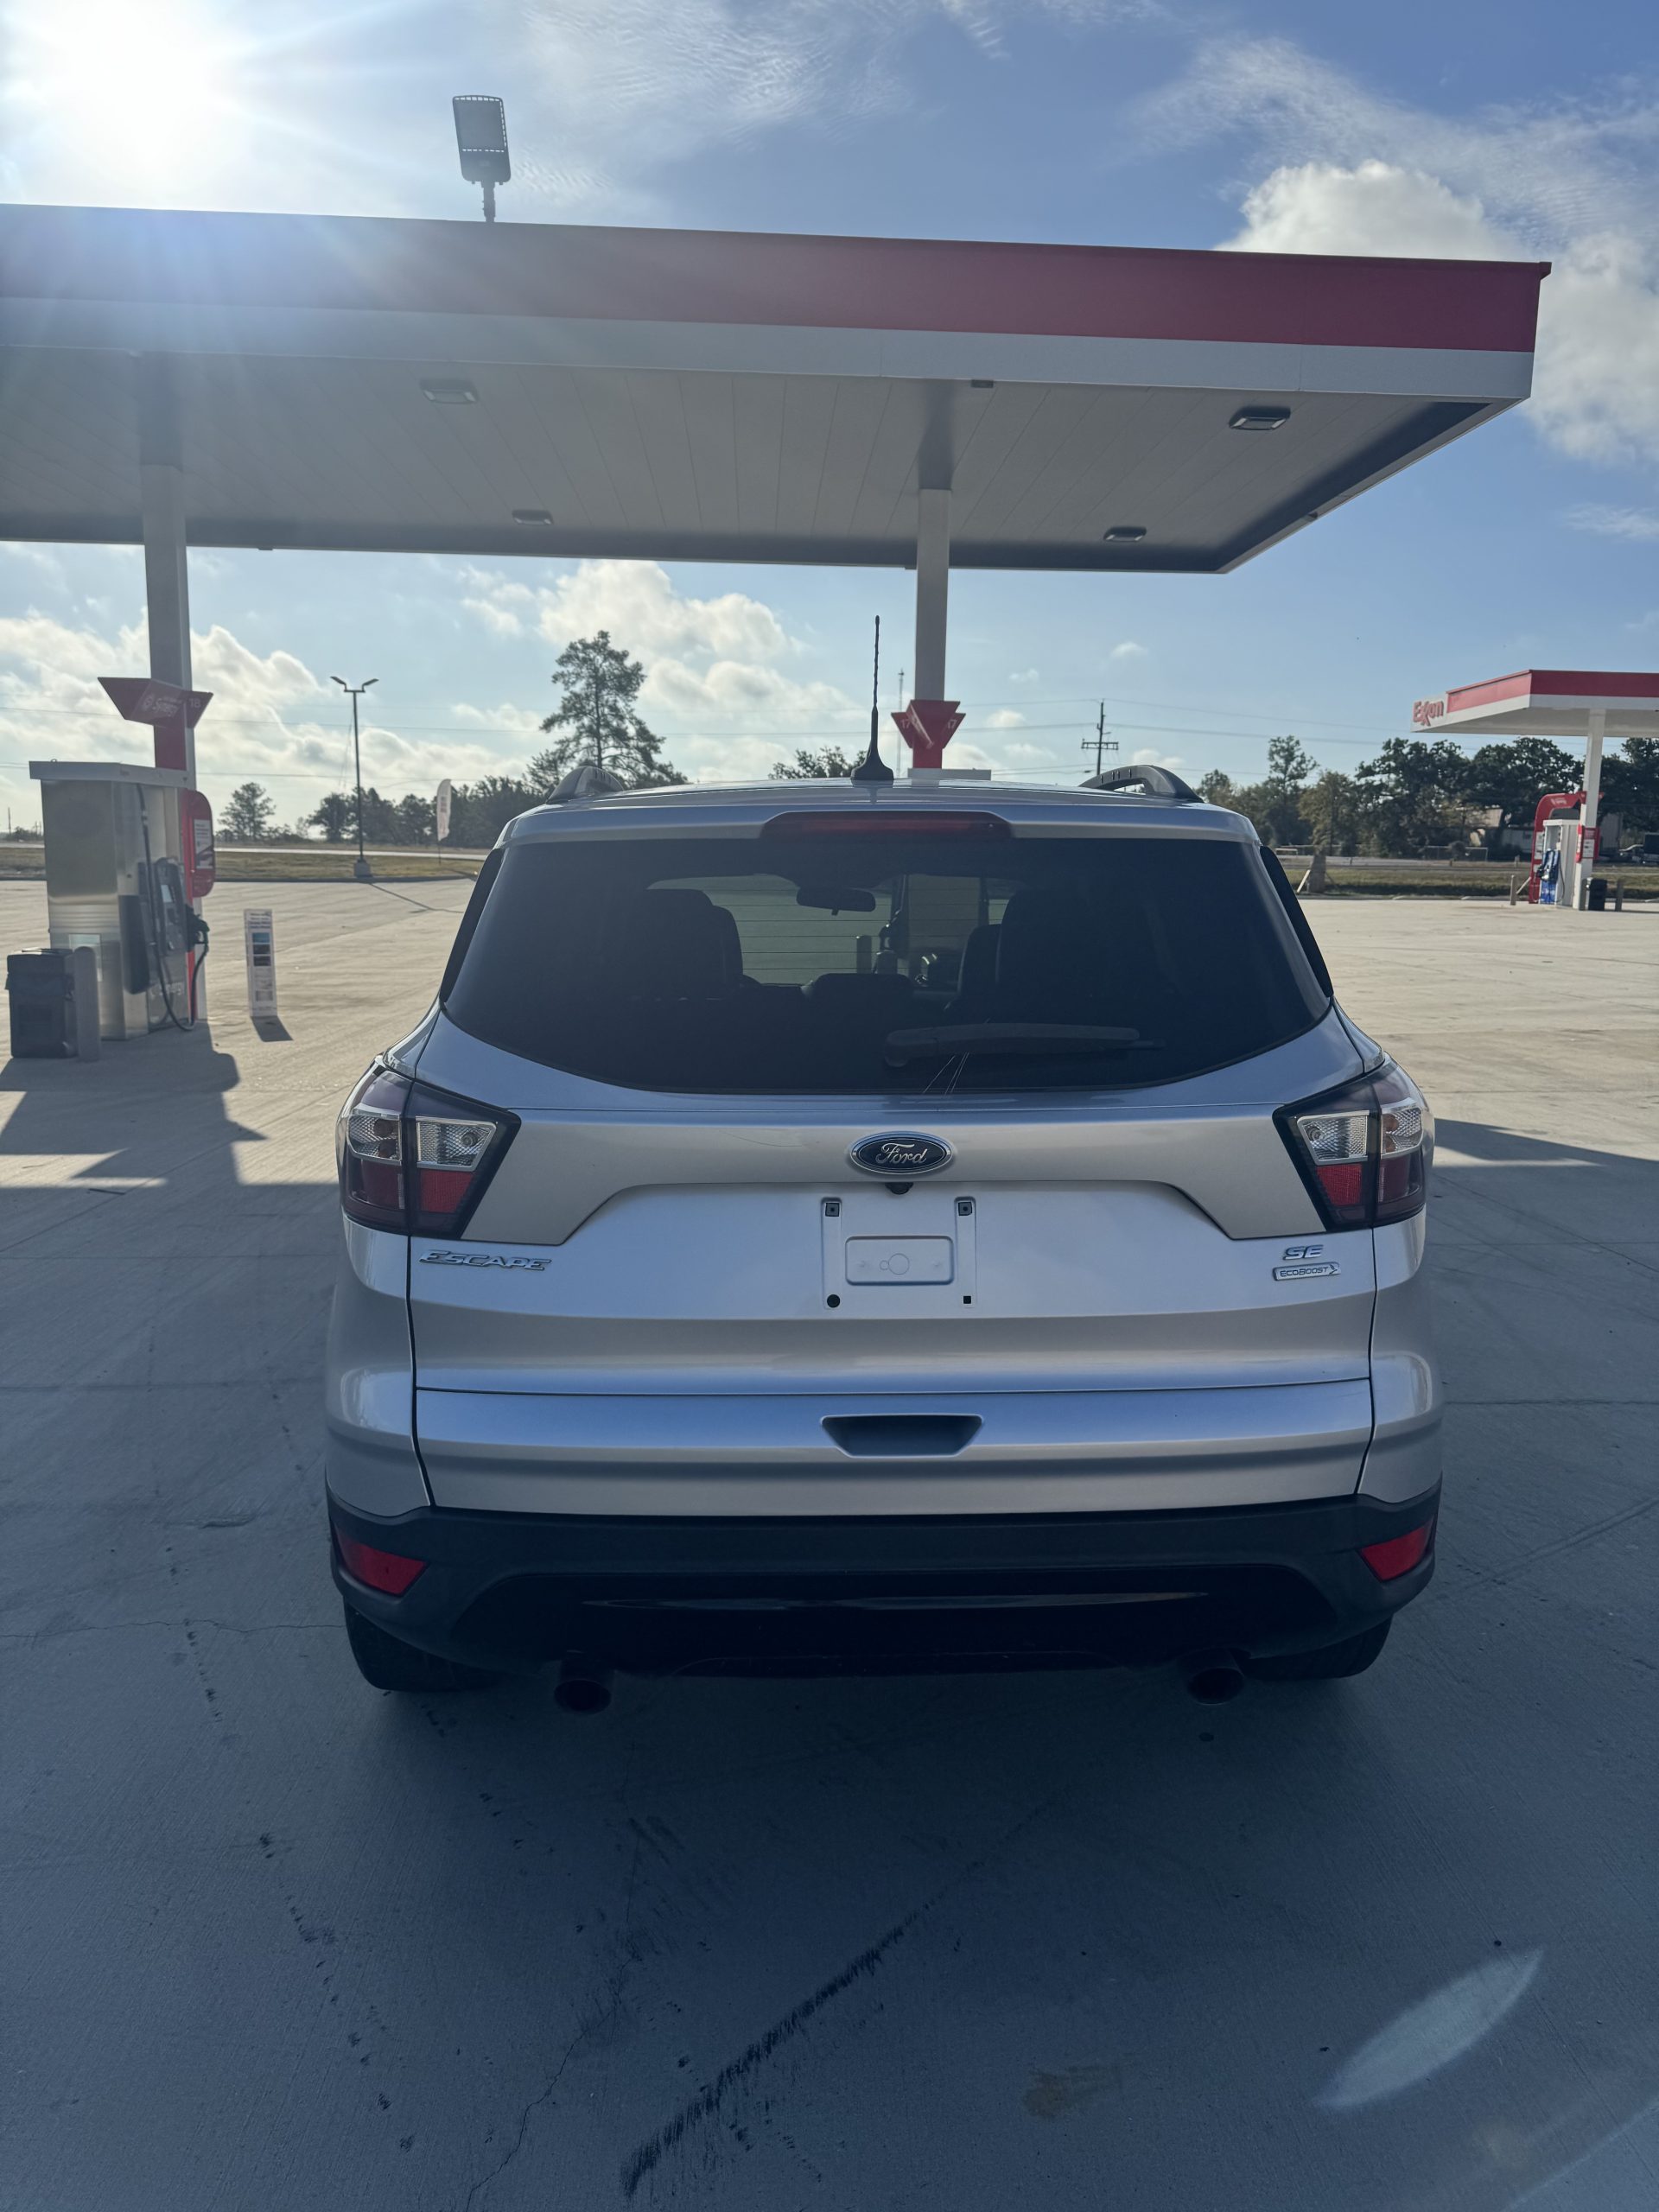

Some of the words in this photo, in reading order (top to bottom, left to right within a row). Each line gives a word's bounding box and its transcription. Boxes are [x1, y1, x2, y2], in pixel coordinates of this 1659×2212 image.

[189, 698, 201, 709] 18
[1412, 701, 1444, 726] Exxon
[875, 1141, 928, 1165] Ford
[419, 1249, 552, 1271] ESCAPE
[1283, 1244, 1324, 1261] SE
[1280, 1266, 1329, 1278] ECOBOOST
